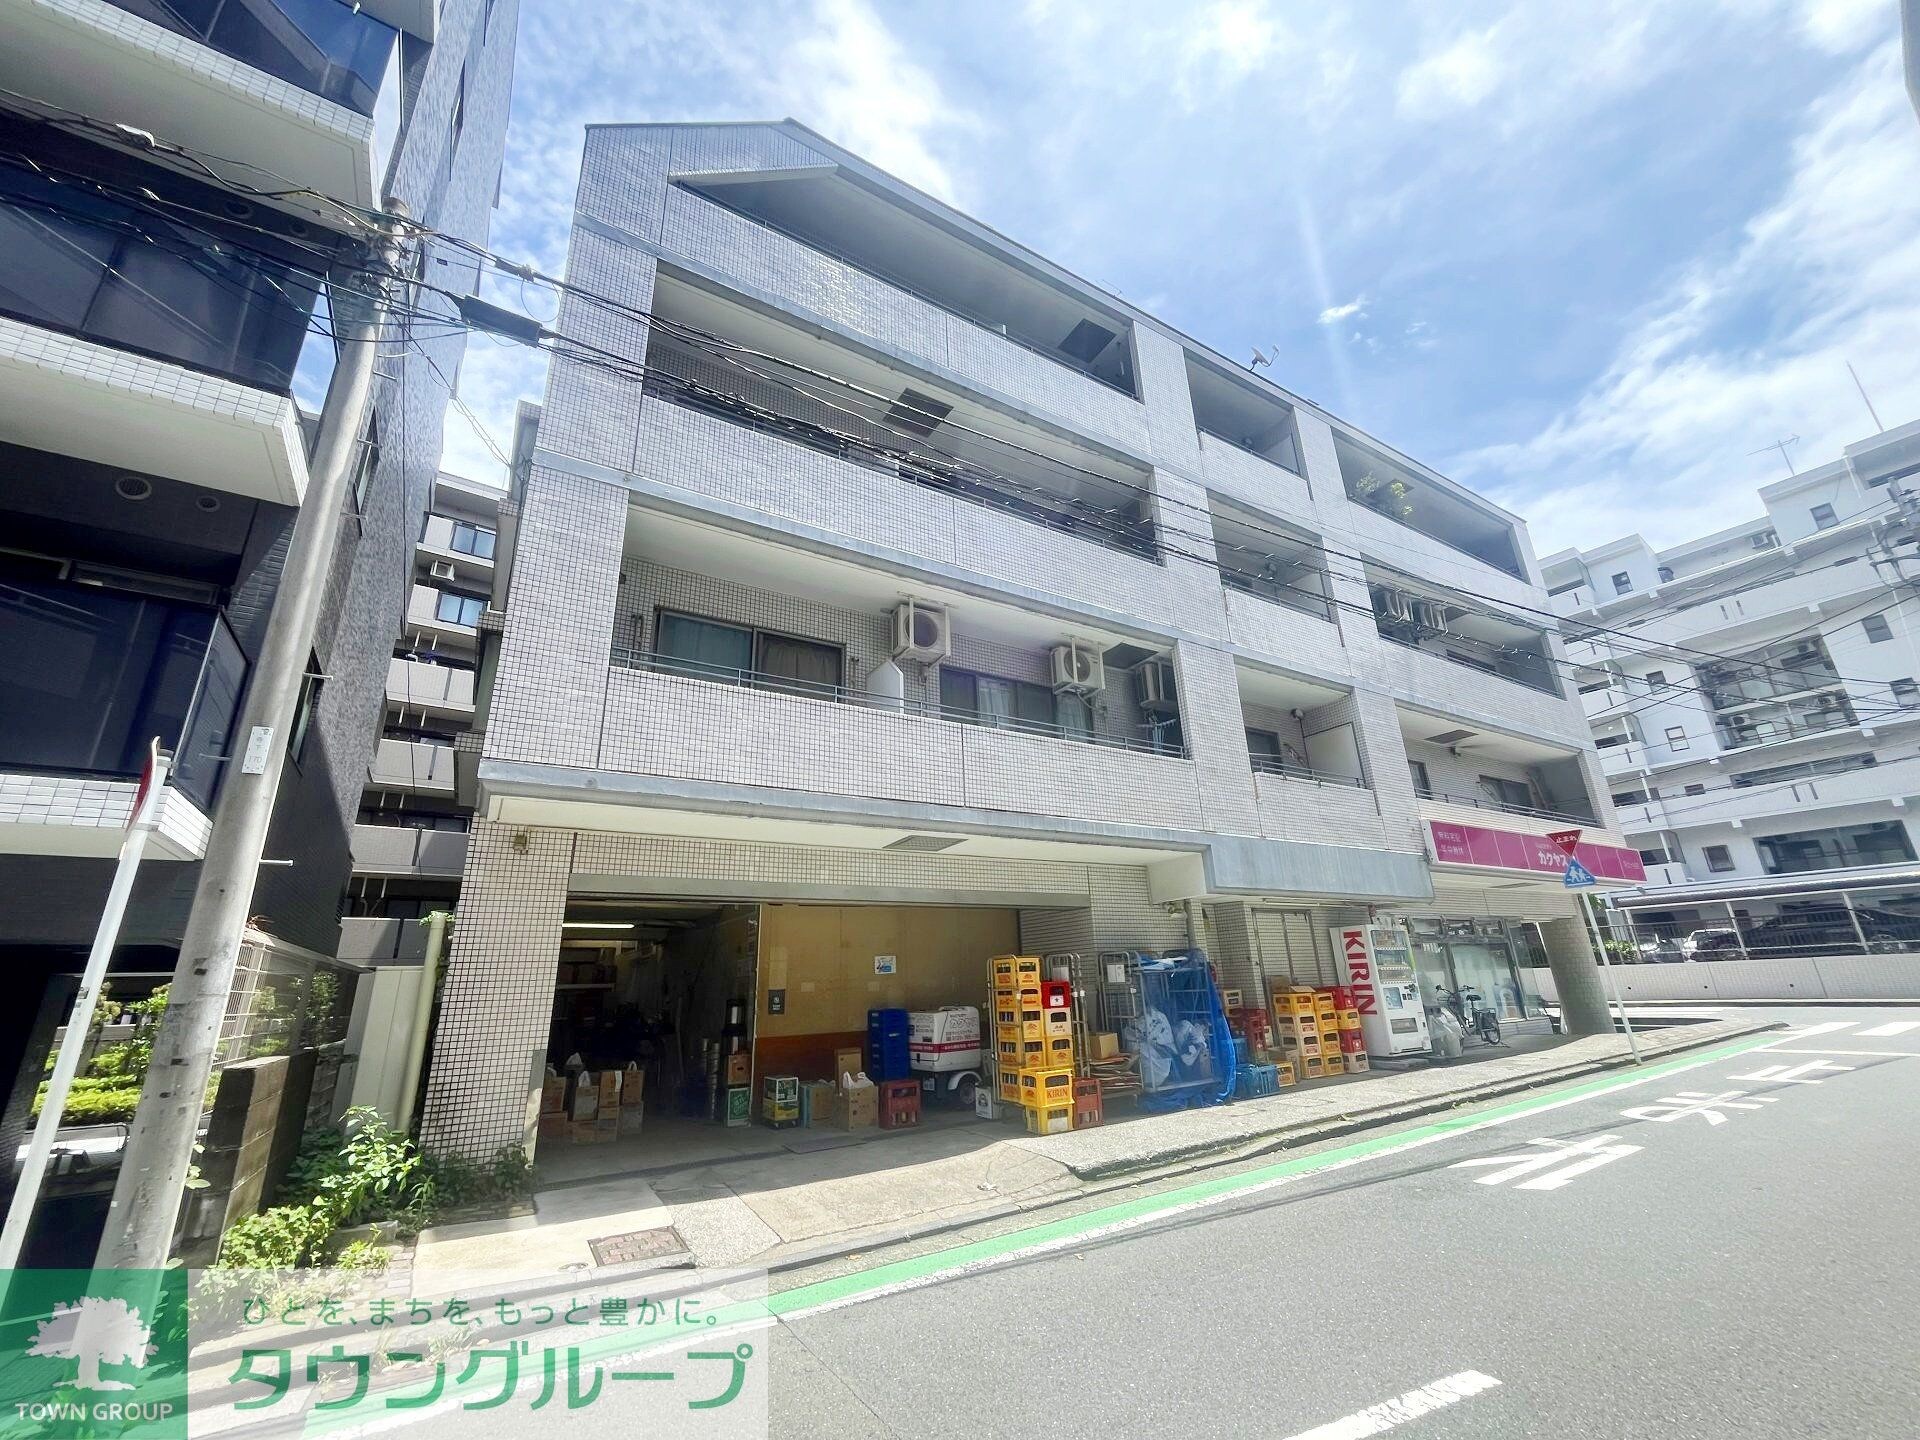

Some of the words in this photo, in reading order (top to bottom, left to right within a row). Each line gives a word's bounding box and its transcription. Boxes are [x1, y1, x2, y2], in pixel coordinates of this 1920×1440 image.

[1556, 835, 1578, 843] 止まれ
[1343, 931, 1378, 1015] KIRIN
[1047, 1086, 1068, 1098] KIRIN
